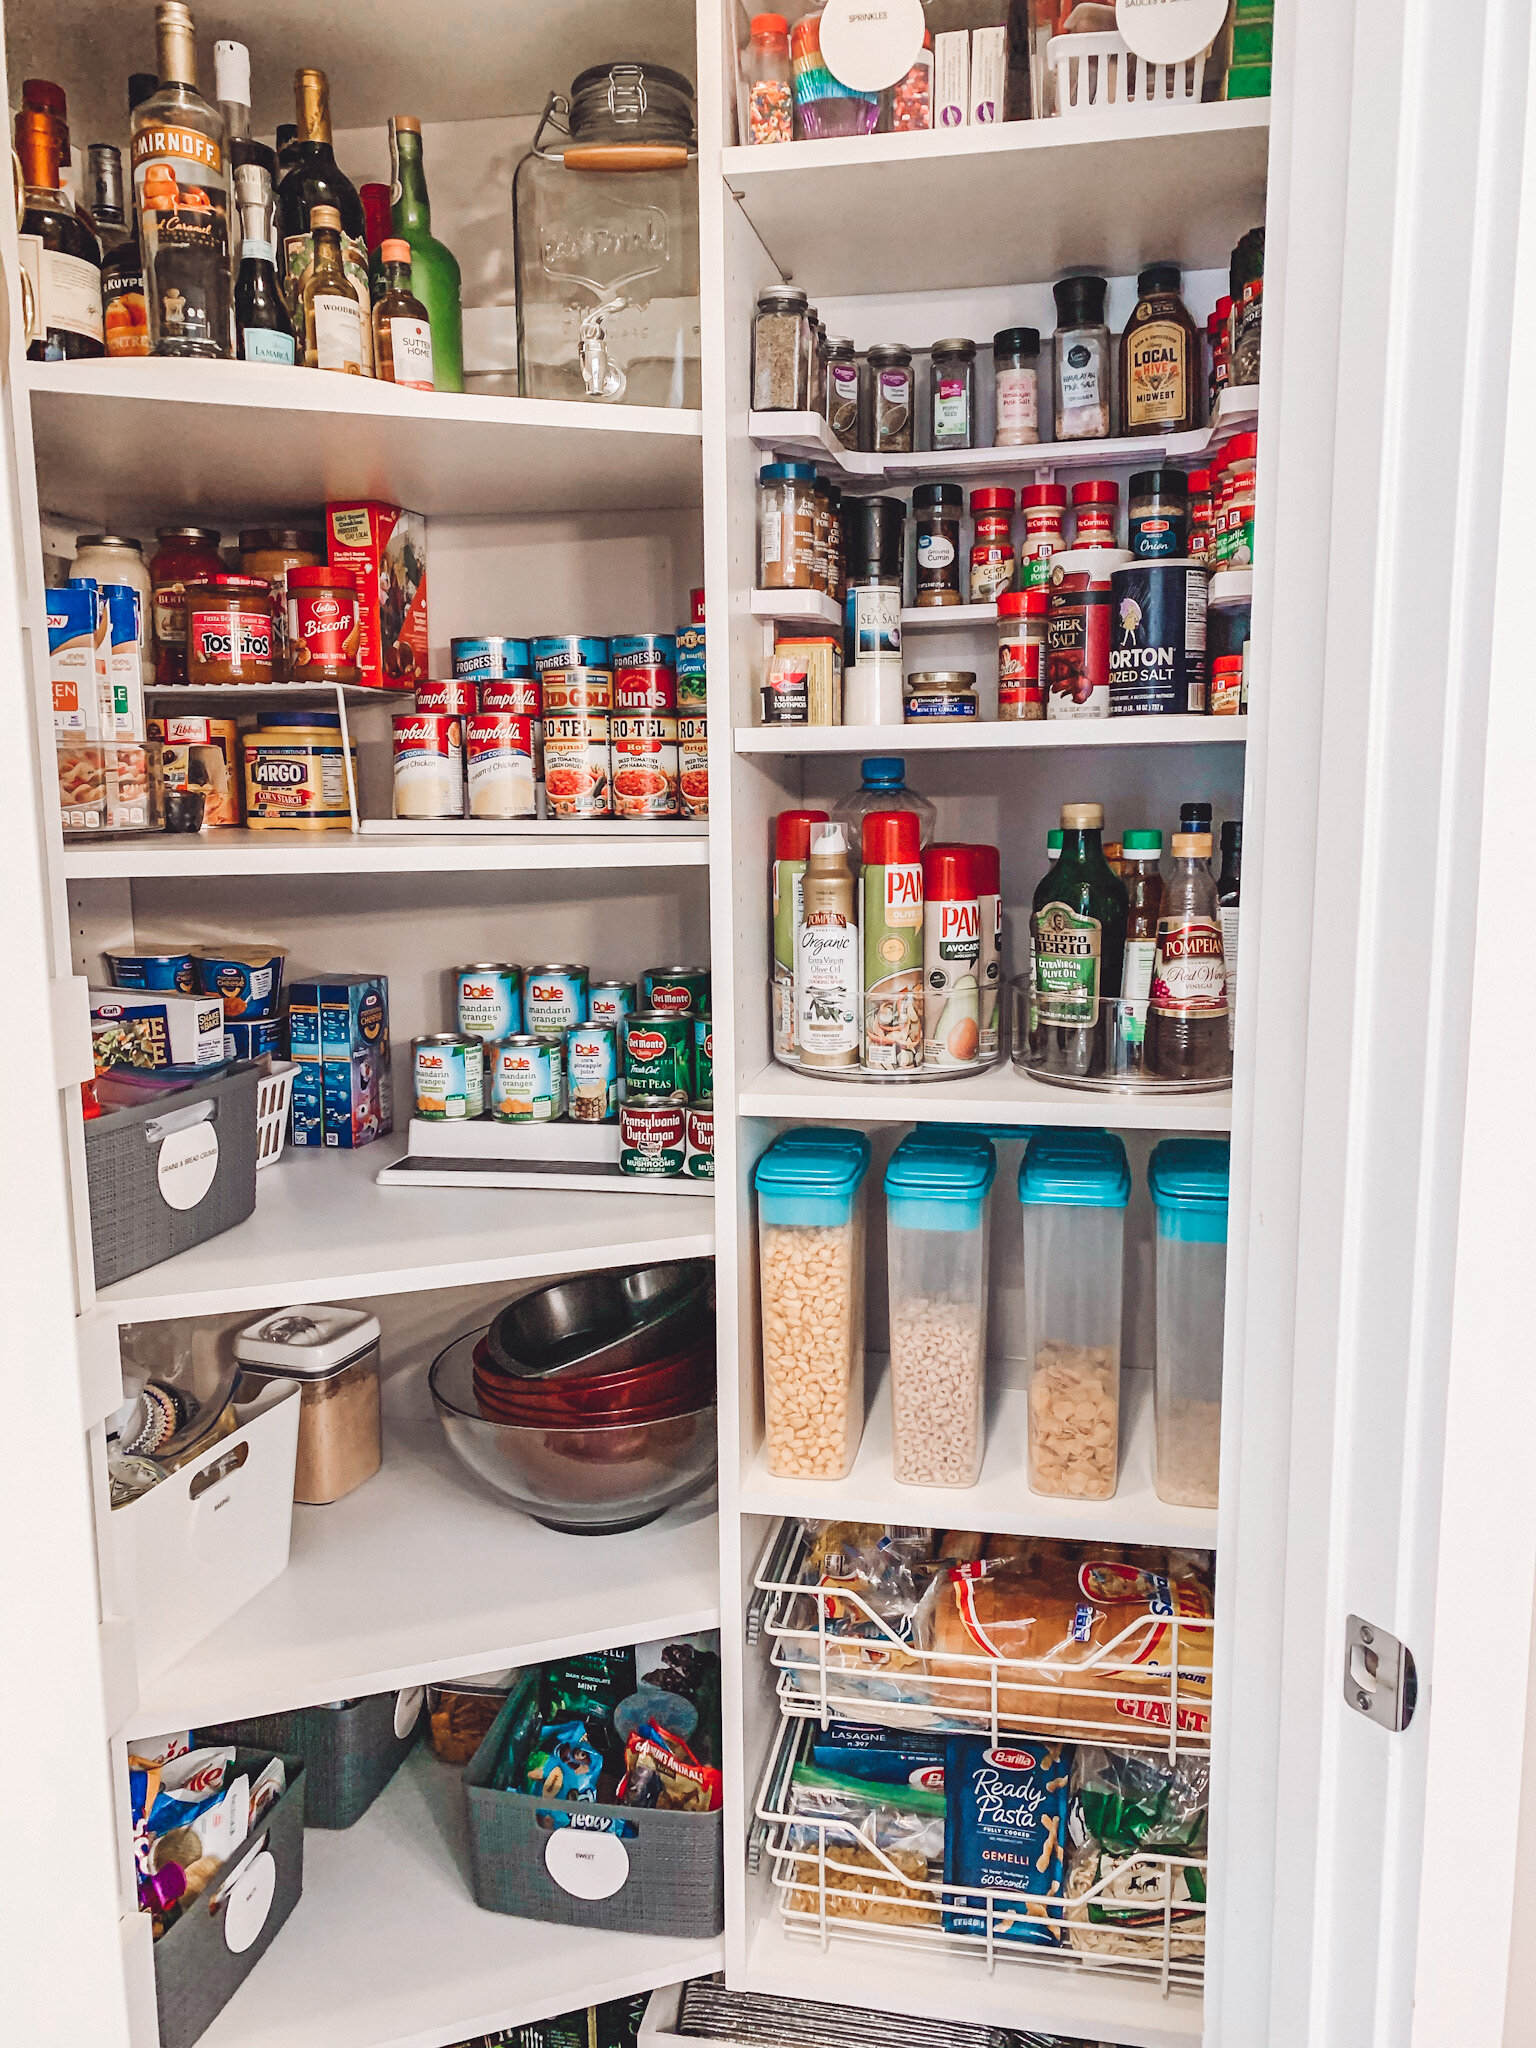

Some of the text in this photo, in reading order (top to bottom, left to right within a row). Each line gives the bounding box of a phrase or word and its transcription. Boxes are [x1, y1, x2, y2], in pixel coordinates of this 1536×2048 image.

[849, 12, 888, 23] SPRINKLES
[407, 347, 430, 358] HOME
[1134, 347, 1178, 367] LOCAL
[1143, 362, 1168, 375] HIVE
[1063, 372, 1096, 383] HIMALAYAN
[1064, 380, 1096, 392] PINK SALT
[1136, 391, 1175, 403] MIDWEST
[1140, 539, 1168, 551] Onion
[983, 564, 1006, 577] Celery
[987, 571, 1003, 581] Salt
[316, 602, 337, 613] Lotus
[861, 612, 900, 624] SEA SALT
[304, 615, 351, 637] Biscoff
[1052, 632, 1076, 648] SALT
[456, 654, 503, 673] PROGRESSO
[535, 652, 582, 673] PROGRESSO
[614, 651, 661, 667] PROGRESSO
[1140, 668, 1174, 682] SALT
[415, 686, 467, 706] Campbell's
[483, 687, 536, 708] Campbell's
[466, 722, 522, 741] Campbell's
[488, 749, 517, 758] COOKING
[626, 743, 649, 752] Hot
[493, 760, 520, 771] Chicken
[257, 764, 302, 782] ARGO
[258, 791, 302, 804] CORN STARCH
[802, 932, 850, 956] Organic
[808, 955, 844, 966] Extra Virgin
[810, 965, 841, 973] Olive Oil
[1042, 969, 1077, 979] OLIVE OIL
[1167, 965, 1225, 982] Red Wine
[463, 983, 494, 999] Dole
[532, 985, 564, 1001] Dole
[653, 993, 689, 1003] Del Monte
[459, 1004, 502, 1013] mandarin
[529, 1006, 571, 1014] mandarin
[593, 1001, 616, 1013] Dole
[198, 1011, 220, 1025] SHAKE
[462, 1014, 498, 1023] oranges
[532, 1016, 567, 1025] oranges
[575, 1043, 600, 1056] Dole
[629, 1038, 664, 1049] Del Monte
[419, 1055, 443, 1067] Dole
[504, 1057, 530, 1070] Dole
[574, 1062, 602, 1070] pineapple
[416, 1070, 449, 1078] mandarin
[499, 1072, 536, 1080] mandarin
[418, 1078, 446, 1086] oranges
[502, 1080, 533, 1088] oranges
[649, 1079, 671, 1089] PEAS
[622, 1110, 680, 1130] Pennsylvania
[627, 1126, 674, 1141] Dutchman
[161, 1162, 179, 1174] GRAINS
[627, 1159, 675, 1168] MUSHROOMS
[577, 1682, 598, 1692] MINT
[1115, 1698, 1208, 1732] GIANT
[831, 1730, 886, 1743] LASAGNE
[995, 1750, 1031, 1766] Barilla
[972, 1768, 1047, 1811] Ready
[976, 1795, 1037, 1828] Pasta
[983, 1826, 1031, 1838] FULLY COOKED
[981, 1850, 1030, 1866] GEMELLI
[981, 1873, 994, 1885] 60
